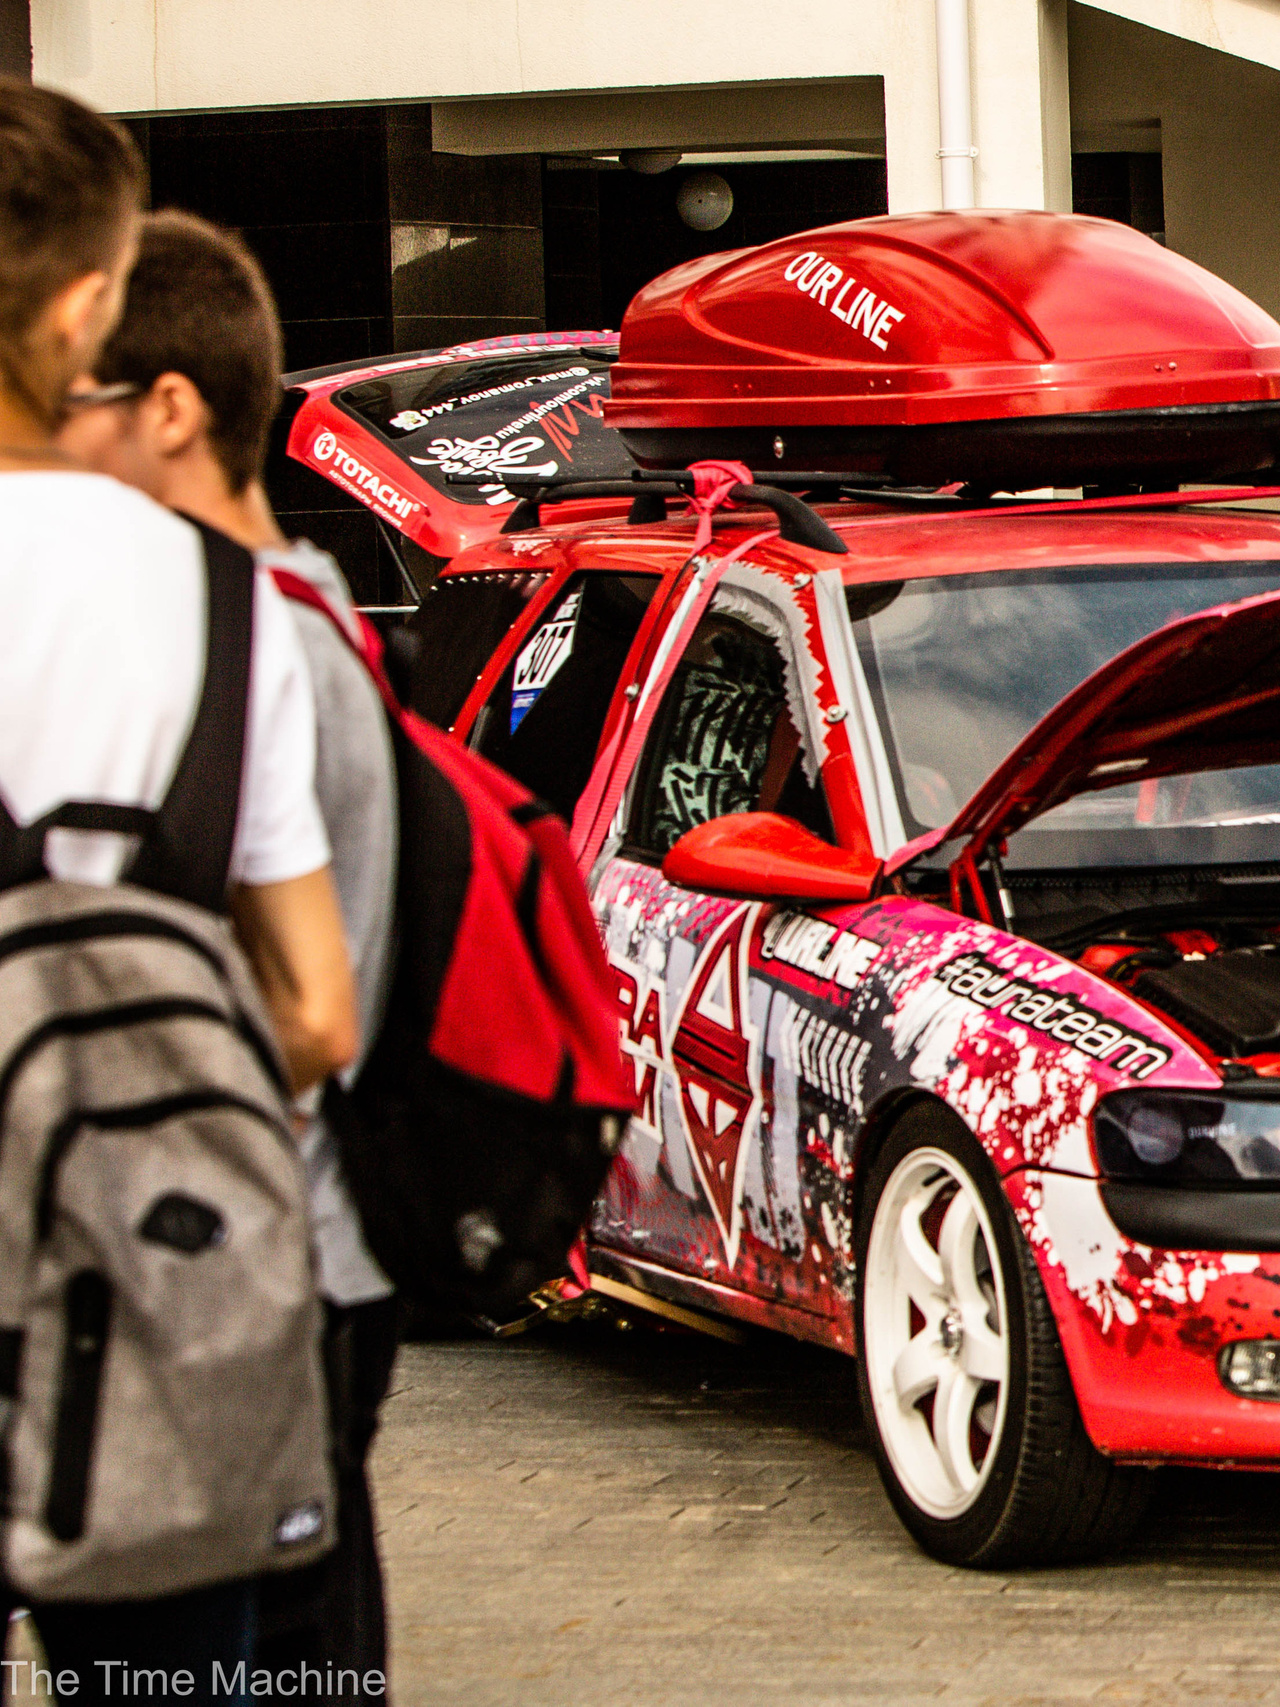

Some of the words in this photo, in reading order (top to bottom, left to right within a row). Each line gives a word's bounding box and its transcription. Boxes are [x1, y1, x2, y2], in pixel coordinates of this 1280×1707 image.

[784, 251, 843, 307] OUR
[829, 277, 906, 352] LINE
[333, 446, 414, 520] TOTACHI
[517, 626, 573, 685] 307
[938, 953, 1170, 1080] #aurateam
